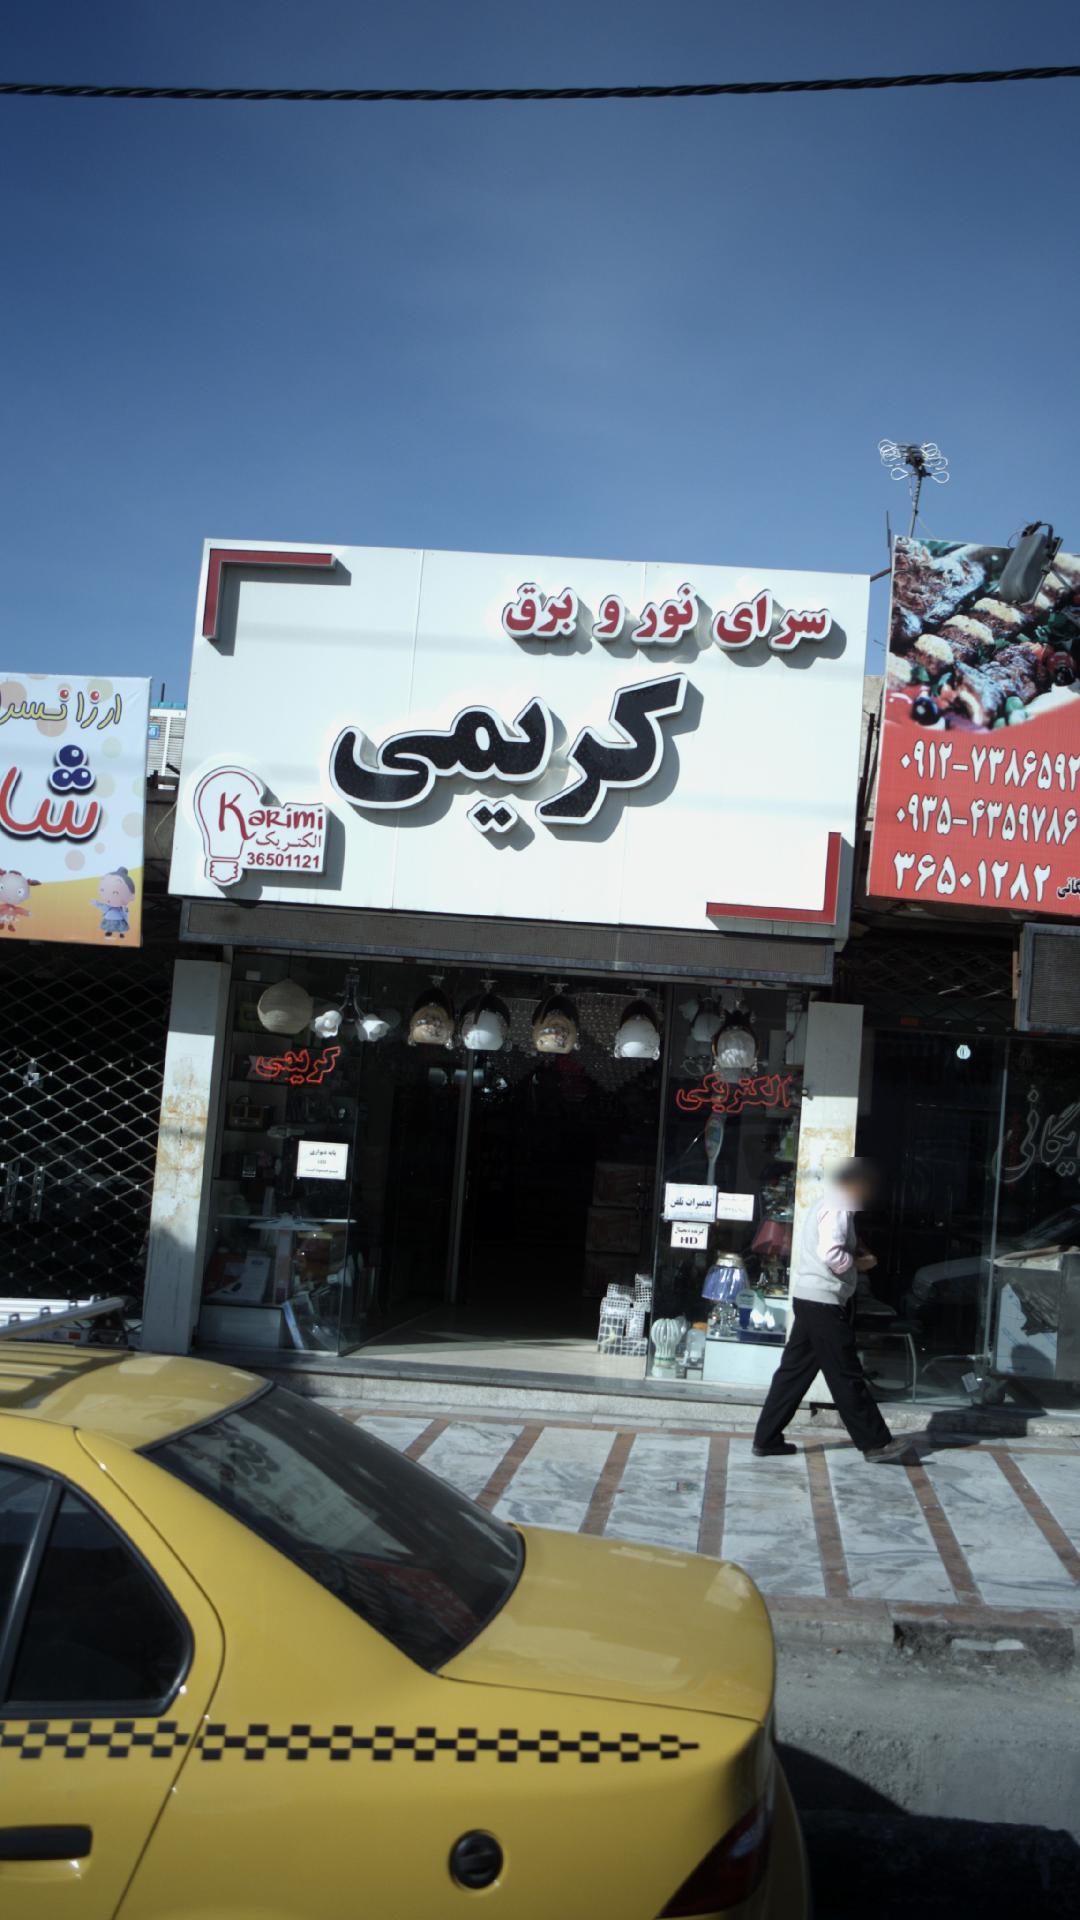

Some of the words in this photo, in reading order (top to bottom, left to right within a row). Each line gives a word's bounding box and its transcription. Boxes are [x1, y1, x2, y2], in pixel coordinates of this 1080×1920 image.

[502, 583, 578, 637] برق
[593, 595, 625, 638] و
[632, 583, 698, 645] نور
[713, 590, 832, 651] سرای
[329, 672, 688, 833] کریمی
[218, 791, 324, 841] Karimi
[255, 831, 322, 851] الکتریک
[896, 793, 1078, 845] ۰۹۳۵-۴۳۵۹۷۸۶
[246, 852, 320, 868] 36501121
[893, 851, 1051, 902] ۳۶۵۰۱۲۸۲
[255, 1046, 342, 1085] کریمی
[685, 1197, 712, 1210] تعمیرات
[680, 1236, 698, 1245] HD
